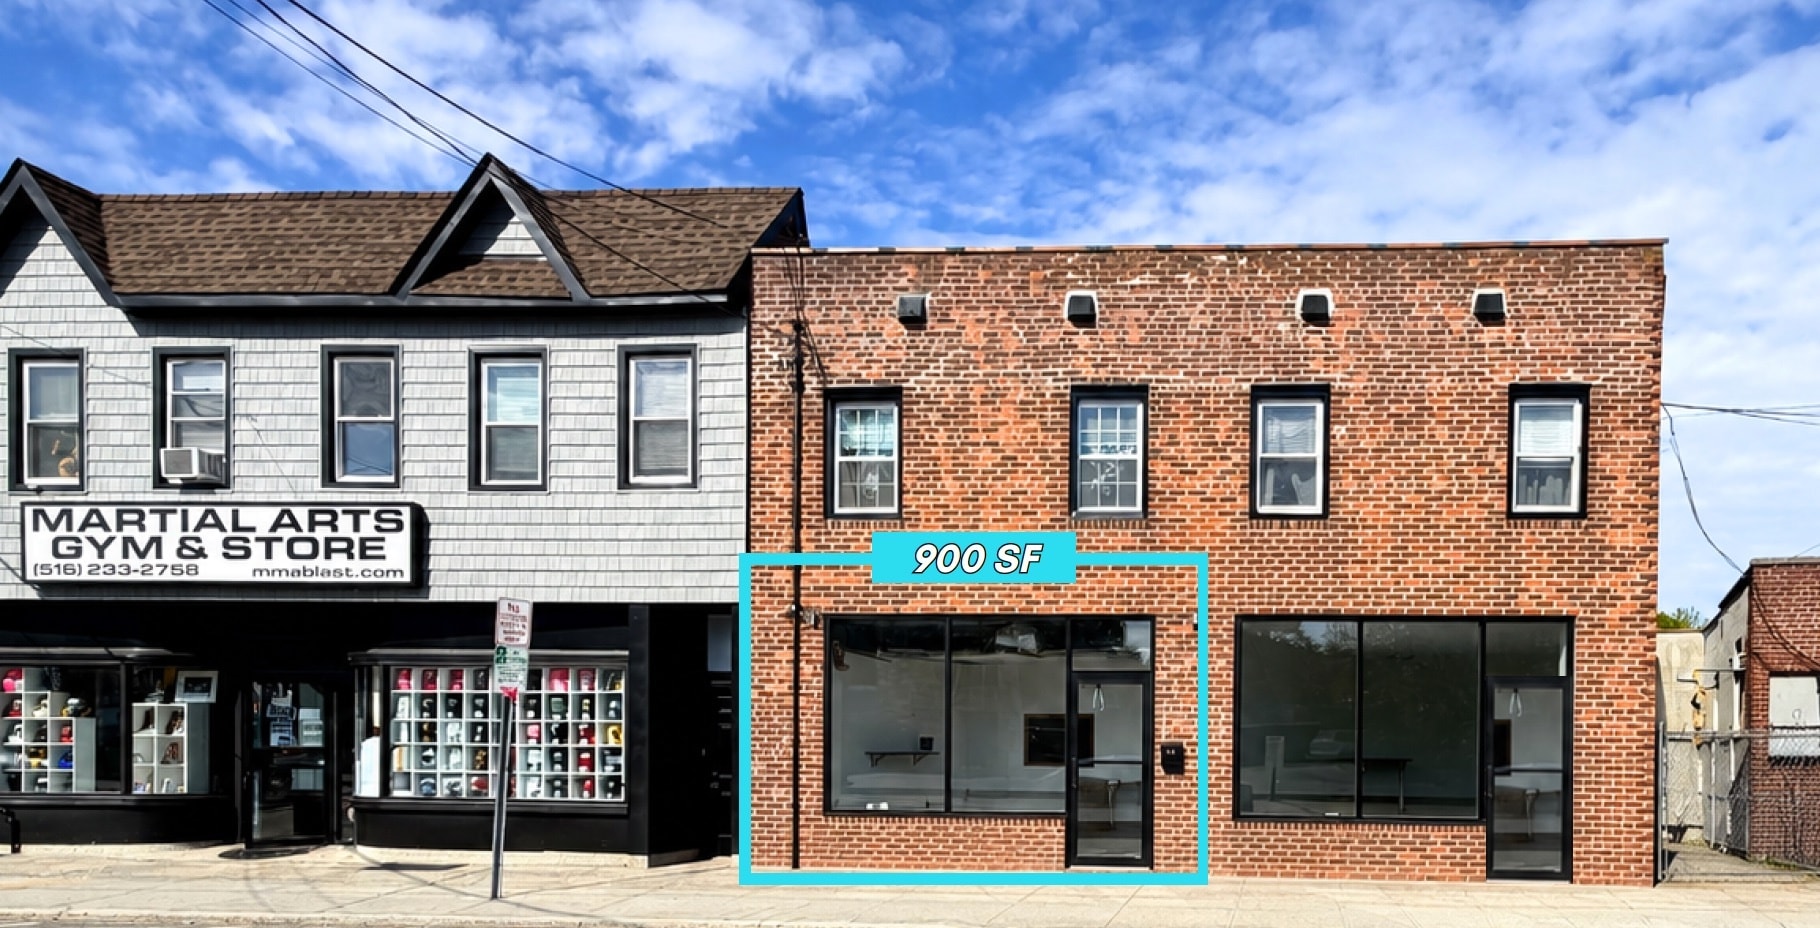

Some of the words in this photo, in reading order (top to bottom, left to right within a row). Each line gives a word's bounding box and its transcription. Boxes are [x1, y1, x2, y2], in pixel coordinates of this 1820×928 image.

[32, 508, 257, 532] MARTIAL
[268, 508, 404, 533] ARTS
[52, 536, 163, 559] GYM
[176, 536, 208, 559] &
[222, 536, 386, 559] STORE
[33, 563, 82, 577] (516)
[87, 563, 200, 576] 233-2758
[252, 565, 405, 578] mmablast.com
